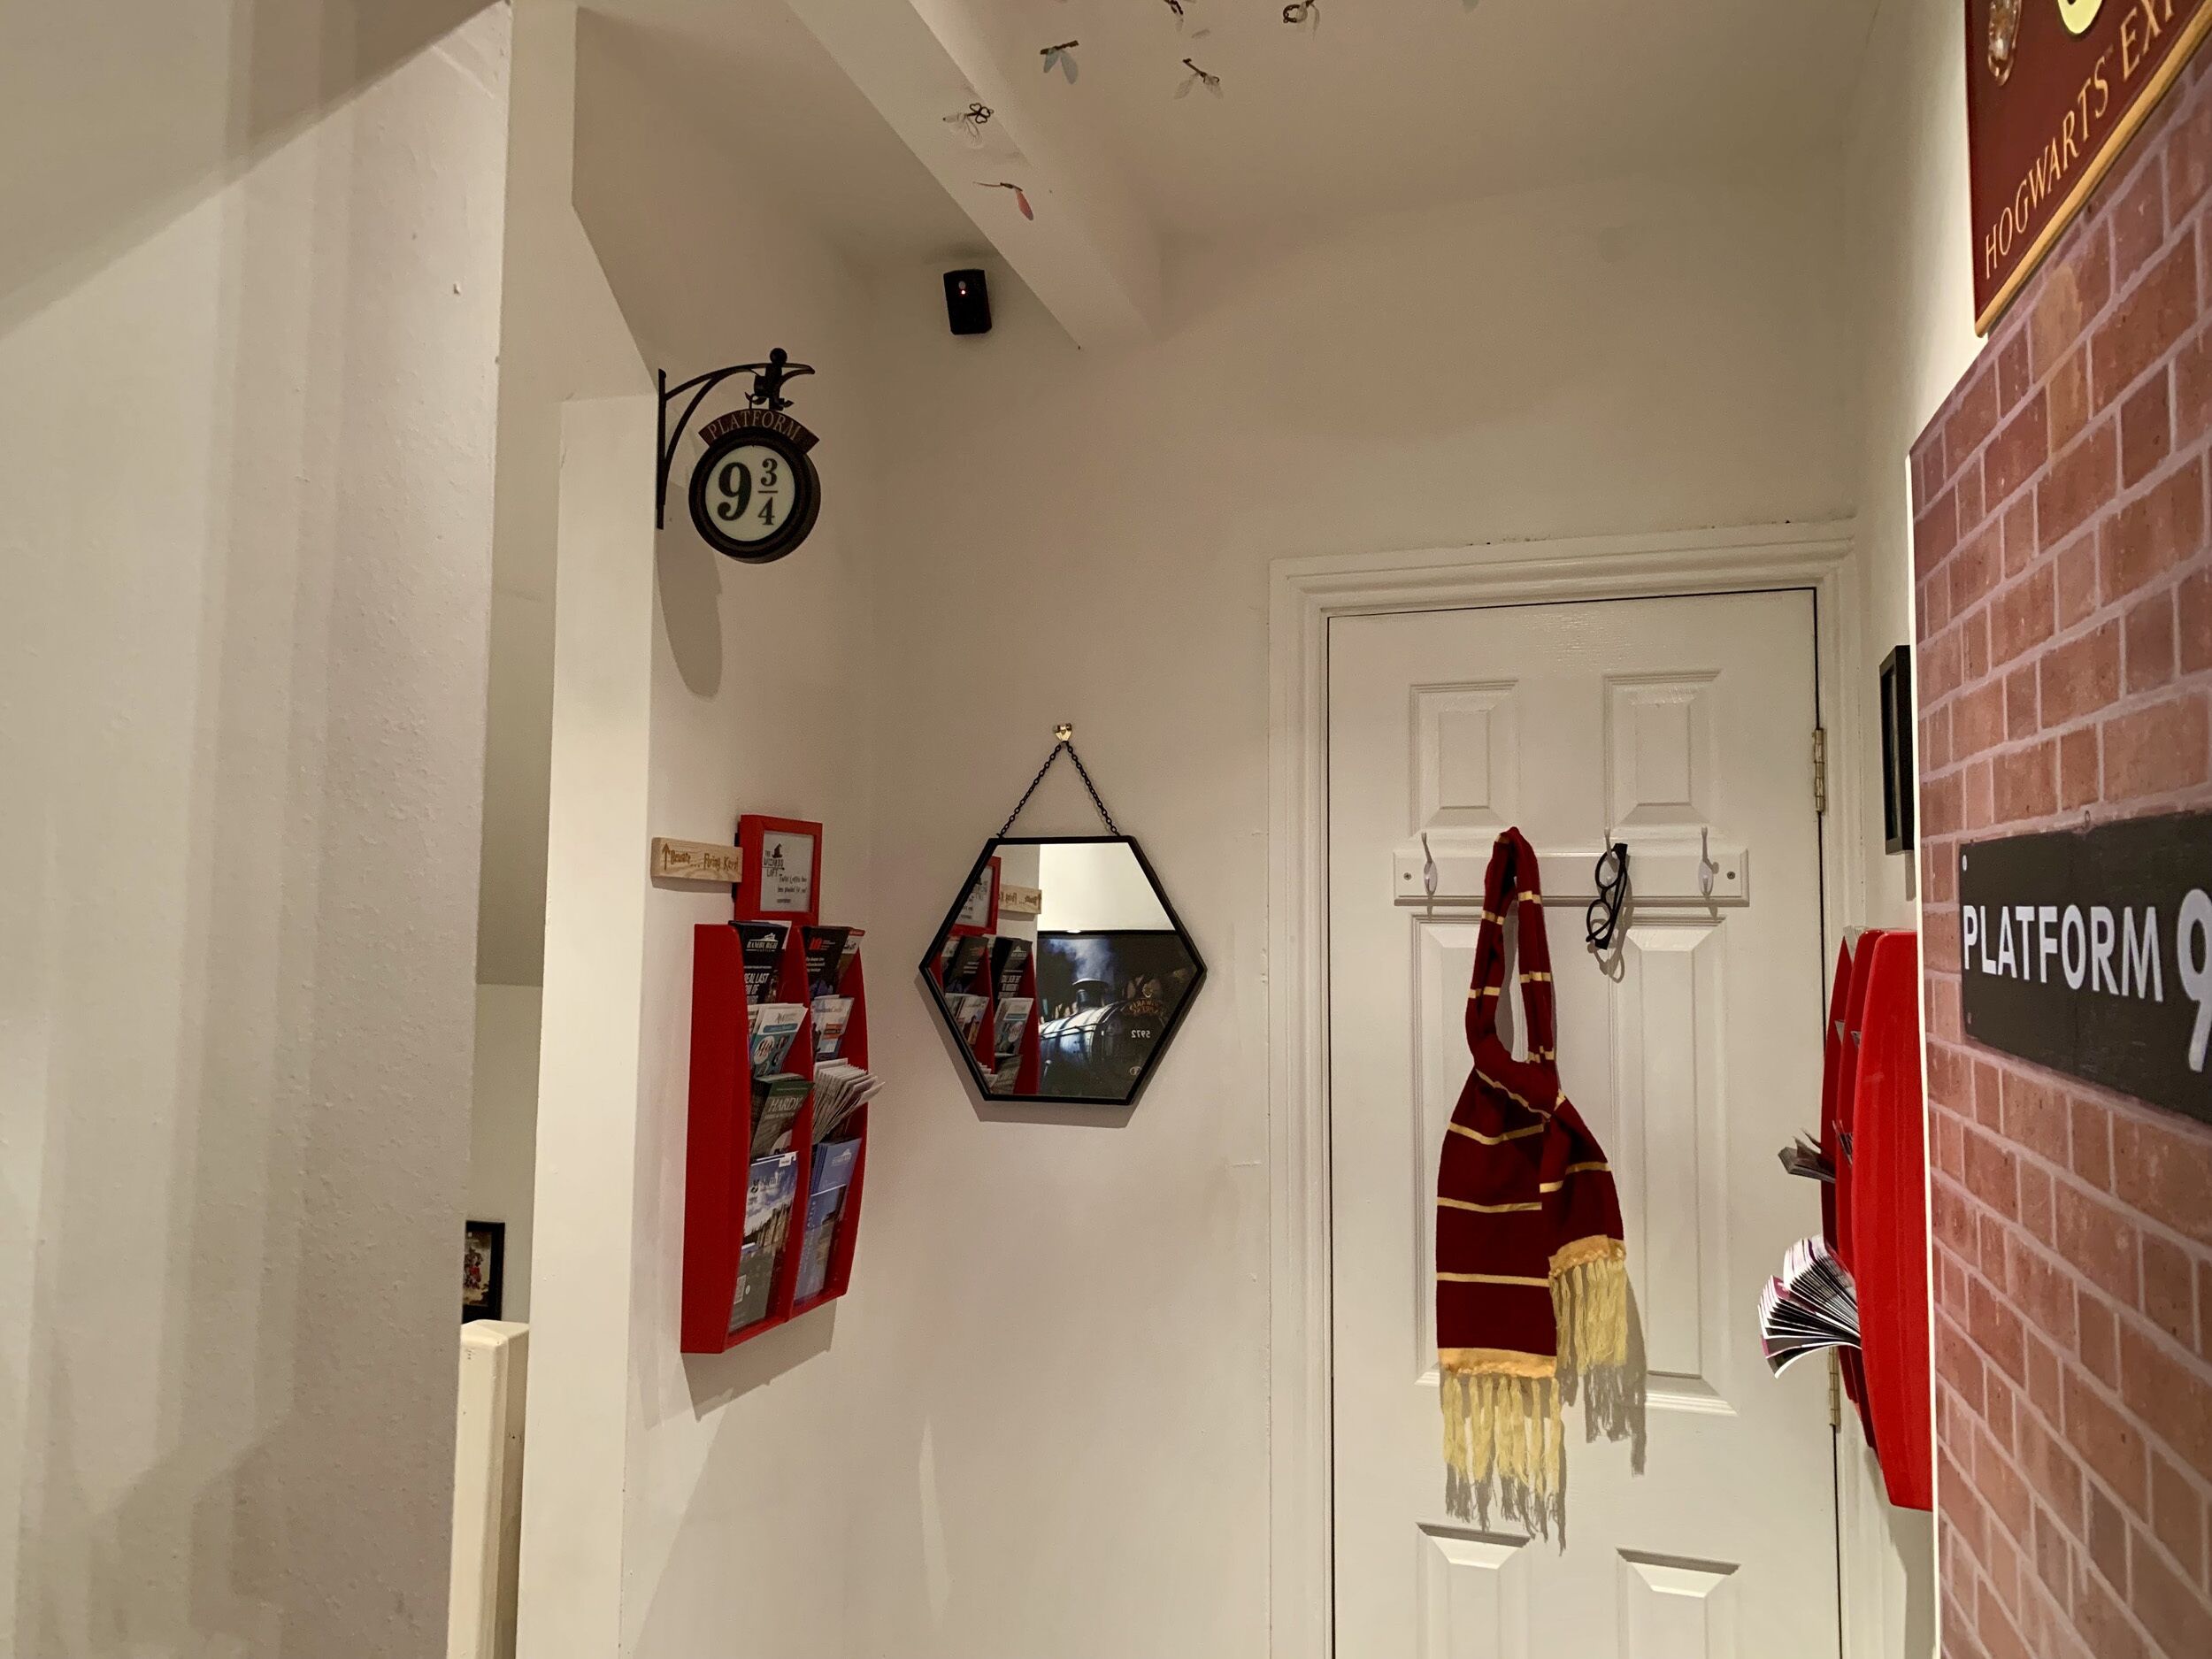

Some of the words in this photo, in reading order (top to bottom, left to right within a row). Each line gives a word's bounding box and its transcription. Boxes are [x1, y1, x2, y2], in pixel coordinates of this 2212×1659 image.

[1985, 44, 2114, 280] HOGWARTS
[708, 410, 802, 441] PLATFORM
[755, 972, 770, 984] LAST
[1962, 903, 2163, 1002] PLATFORM
[2177, 888, 2212, 1073] 9
